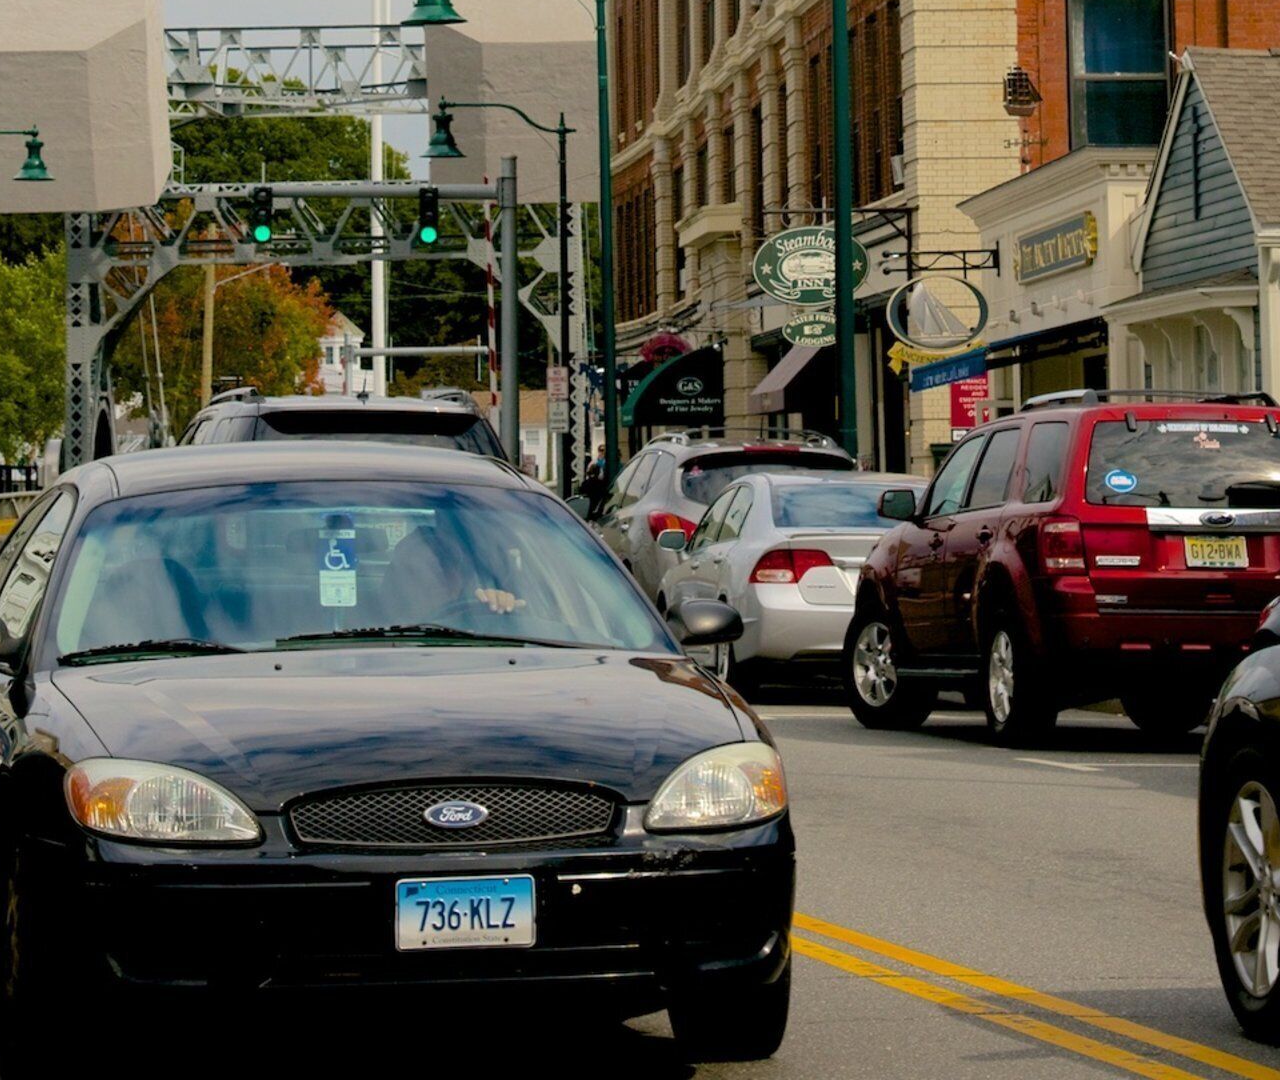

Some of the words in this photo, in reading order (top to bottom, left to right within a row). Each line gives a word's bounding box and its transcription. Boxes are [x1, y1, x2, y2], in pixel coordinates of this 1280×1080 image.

[775, 230, 835, 257] Steambo
[797, 279, 824, 288] INN
[659, 398, 690, 406] Designers
[690, 405, 714, 414] Jewelry
[438, 806, 473, 822] Ford
[435, 885, 497, 895] Connecticut
[432, 936, 480, 944] Constitution
[482, 935, 500, 943] State
